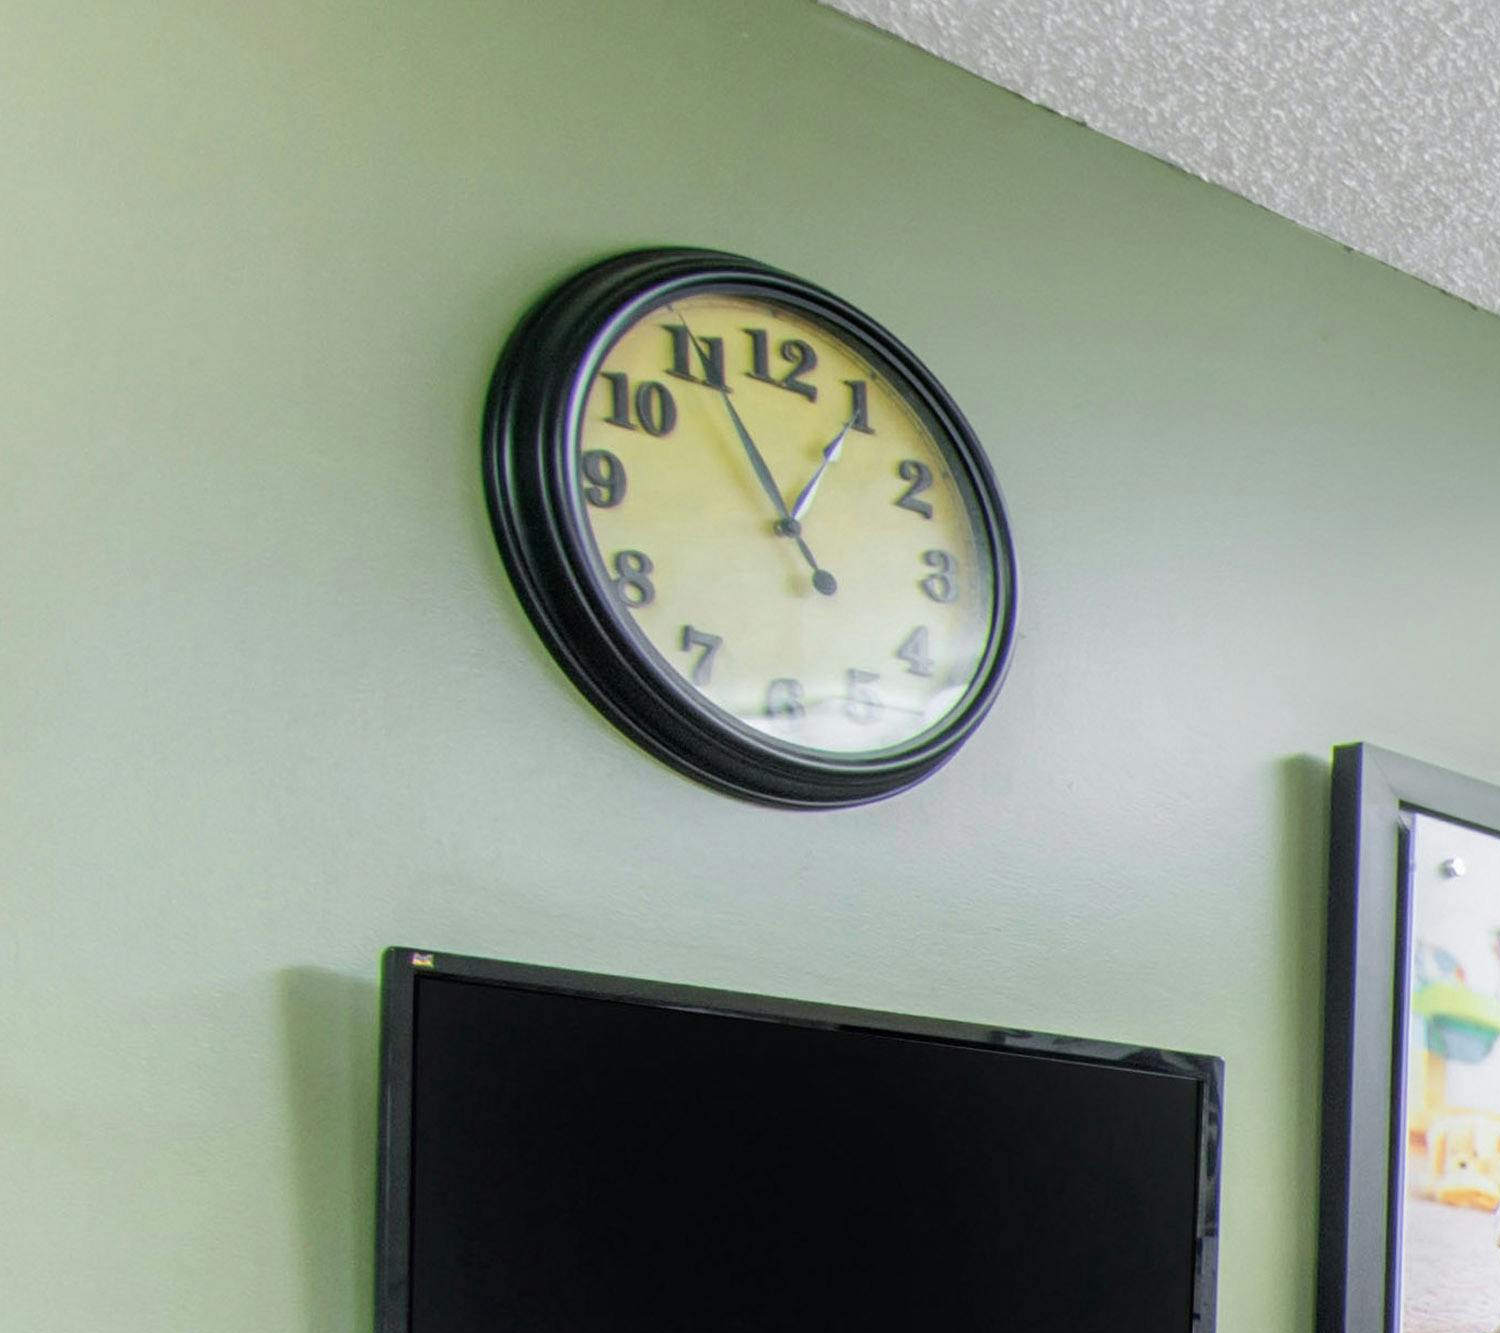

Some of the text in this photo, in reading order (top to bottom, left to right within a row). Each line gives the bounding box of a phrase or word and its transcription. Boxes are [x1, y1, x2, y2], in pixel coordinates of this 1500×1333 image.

[661, 324, 731, 393] 11
[744, 328, 818, 402] 12
[603, 372, 677, 437] 10
[844, 380, 876, 434] 1
[583, 449, 626, 508] 9
[895, 460, 934, 519] 2
[613, 550, 654, 607] 8
[921, 549, 957, 602] 3
[683, 625, 723, 685] 7
[898, 626, 933, 677] 4
[766, 678, 805, 718] 6
[844, 669, 882, 722] 5
